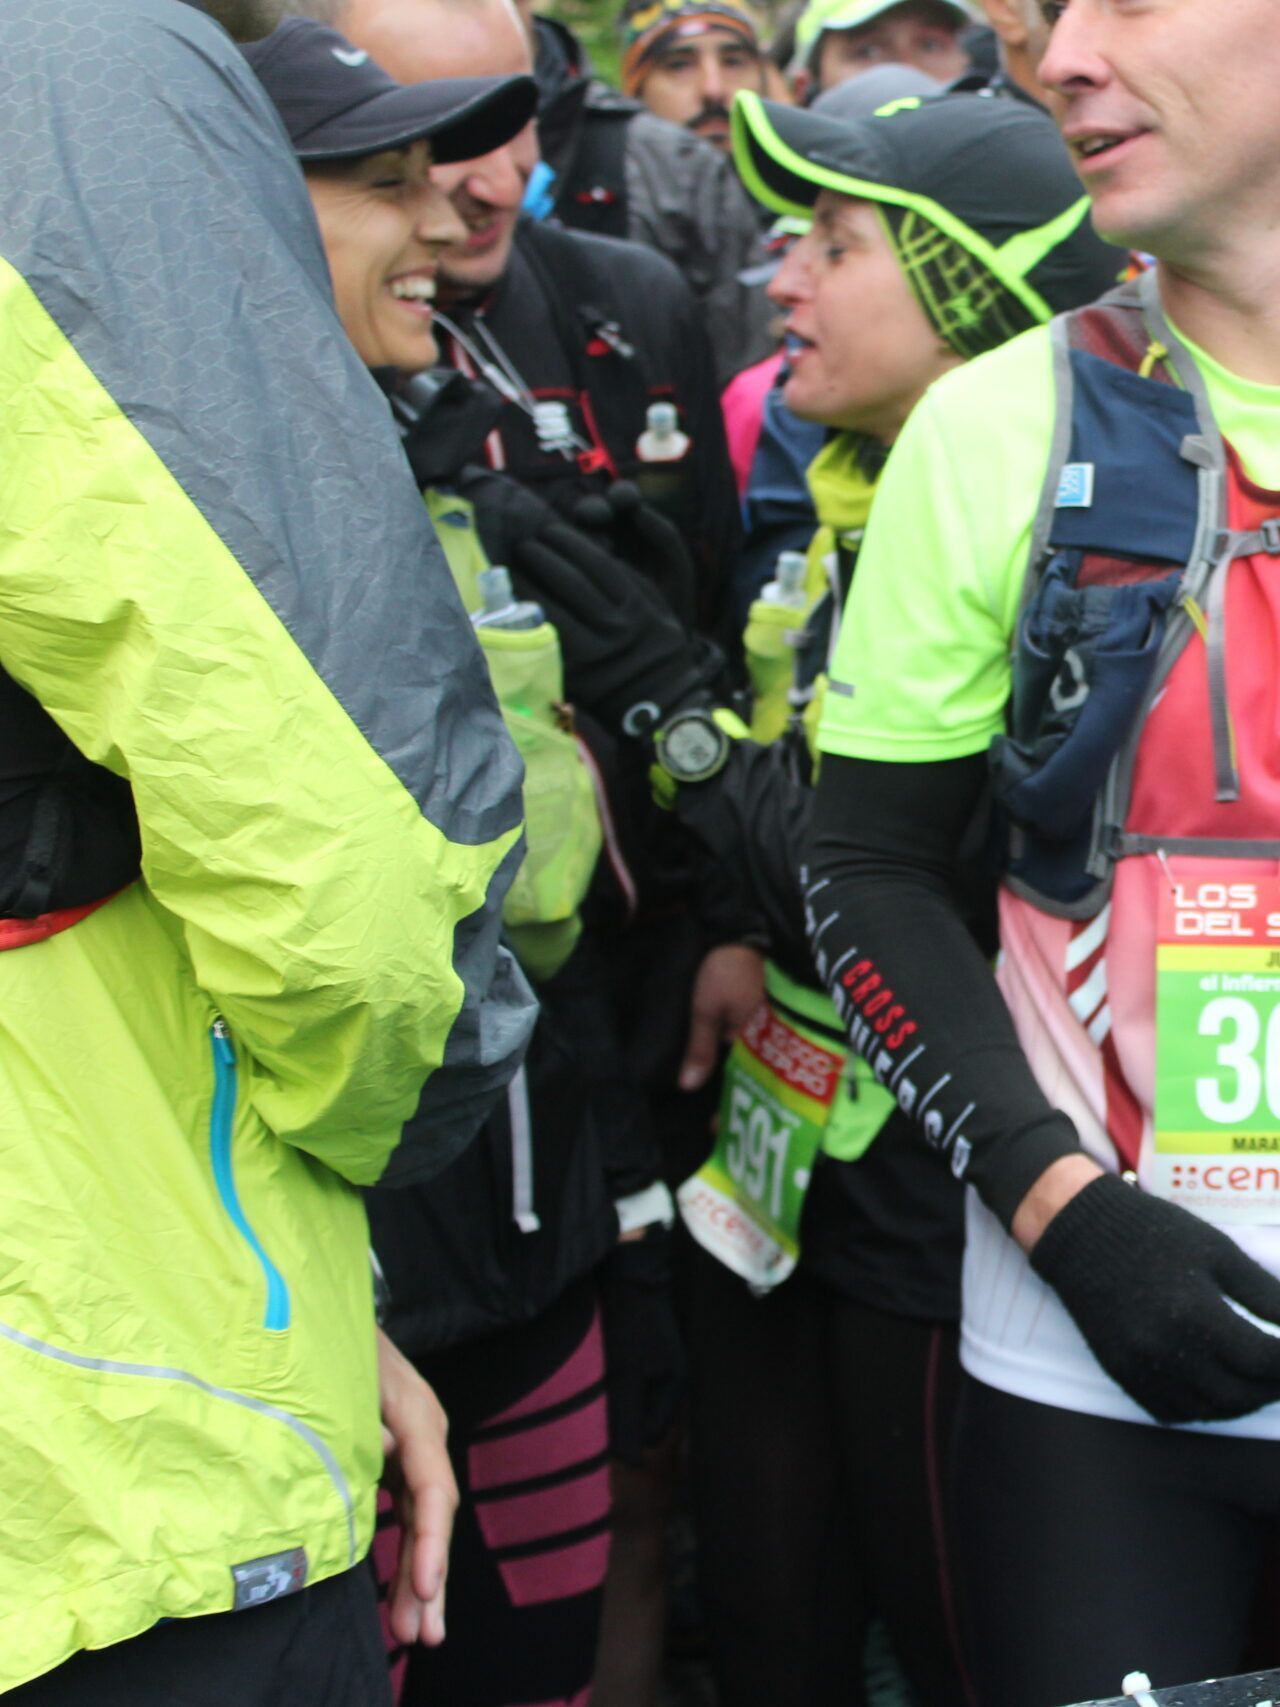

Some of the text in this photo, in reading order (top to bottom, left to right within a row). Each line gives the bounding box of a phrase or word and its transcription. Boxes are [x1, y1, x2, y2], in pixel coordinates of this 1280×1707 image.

[1174, 884, 1257, 909] LOS
[1174, 911, 1255, 937] DEL
[1199, 974, 1218, 992] el
[841, 959, 918, 1050] CROSS
[725, 1084, 793, 1218] 591
